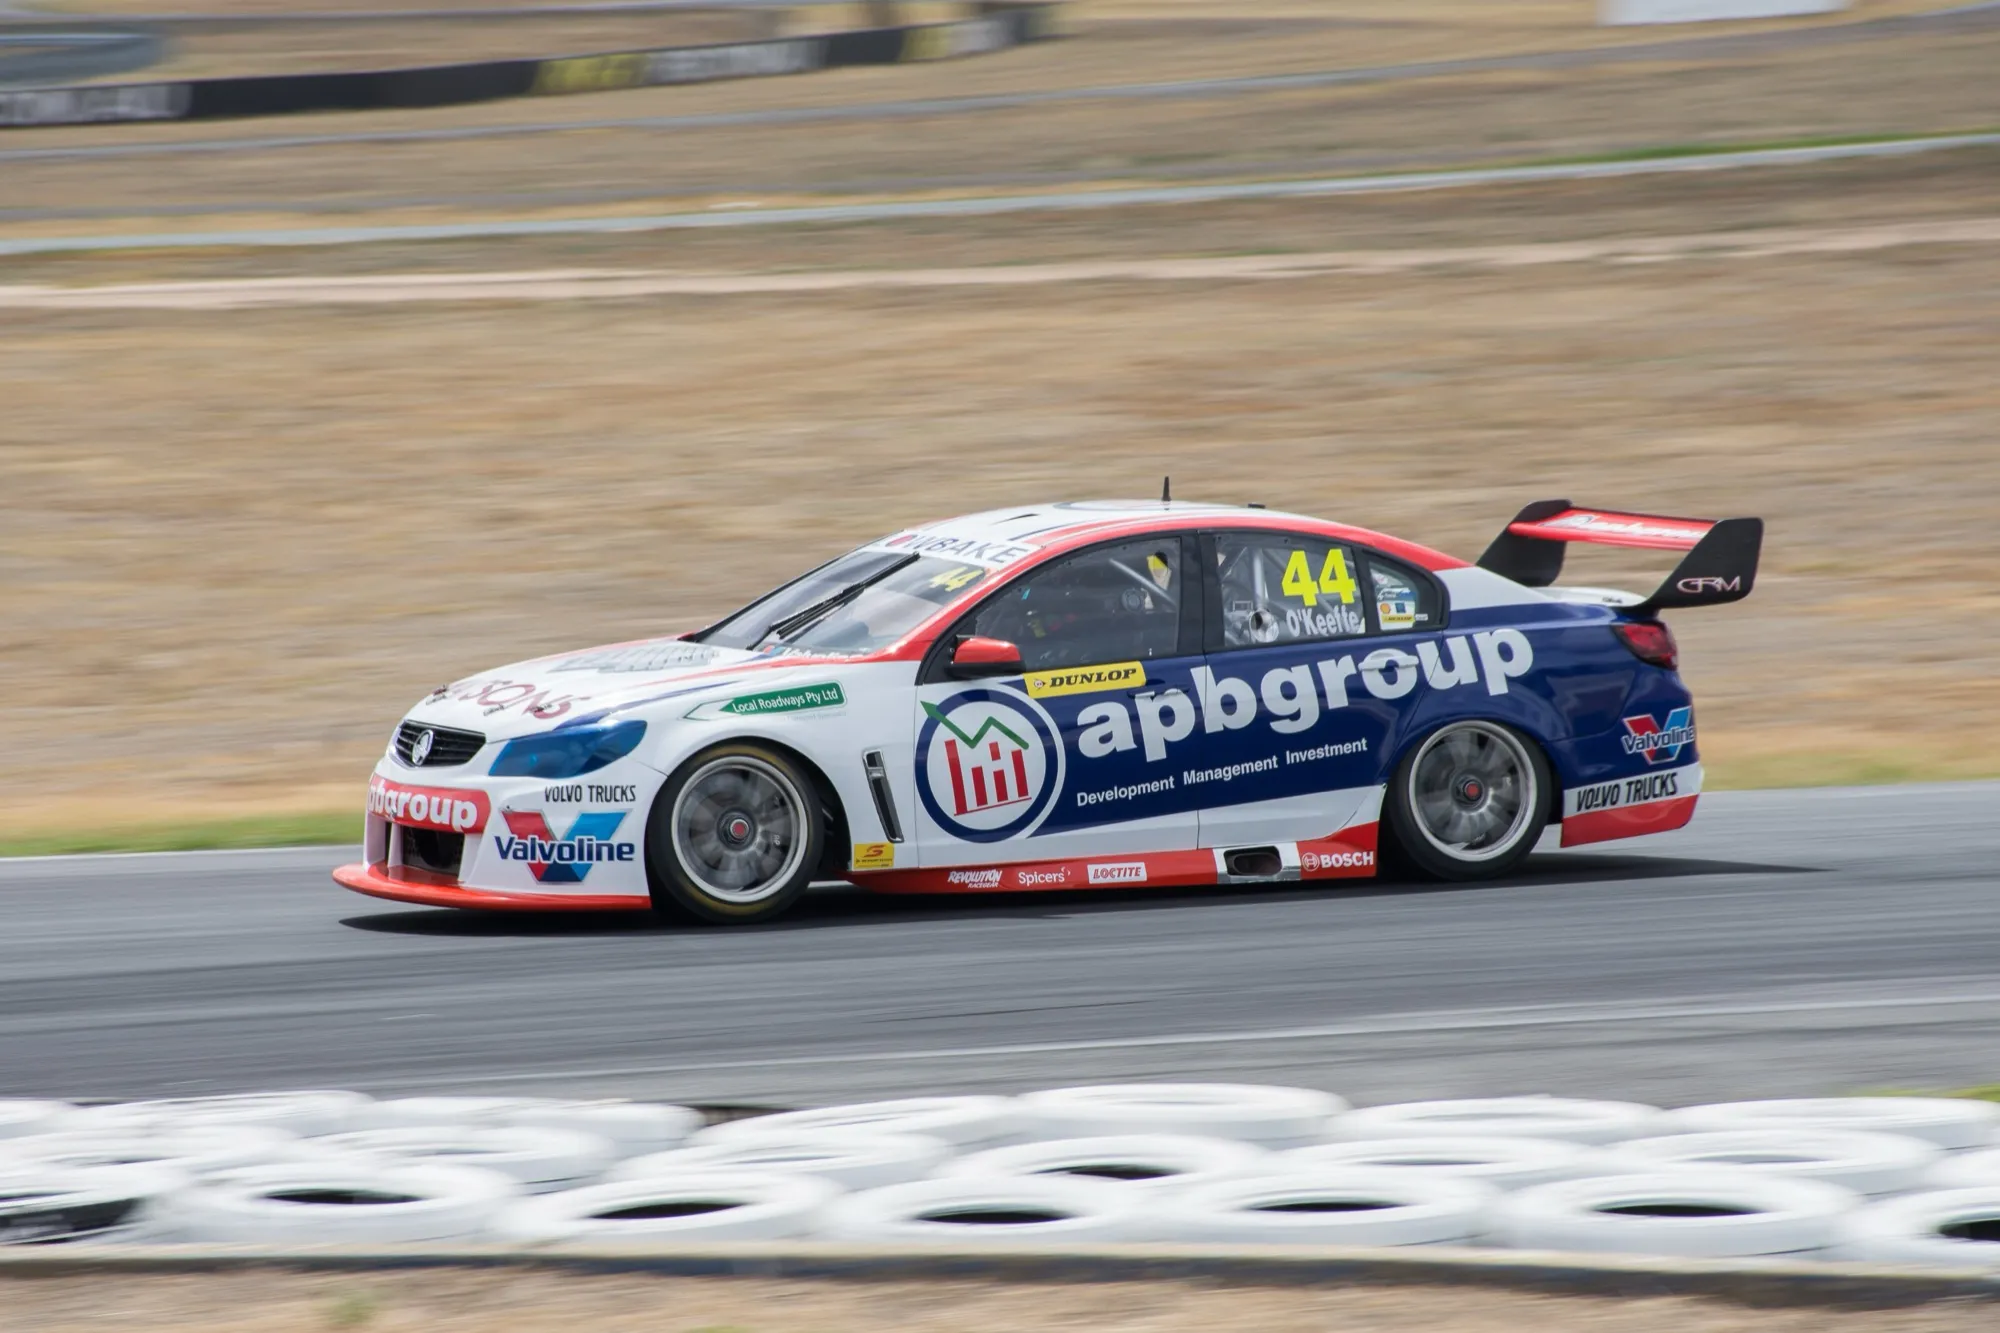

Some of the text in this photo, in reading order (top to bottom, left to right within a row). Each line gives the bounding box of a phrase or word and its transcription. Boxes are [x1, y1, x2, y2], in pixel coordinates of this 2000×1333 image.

[1281, 548, 1357, 607] 44
[1676, 575, 1742, 594] GRM
[1285, 604, 1360, 638] O'Keeffe
[1049, 667, 1137, 689] DUNLOP
[732, 687, 839, 714] Local Roadways Pty Ltd
[1076, 628, 1534, 762] apbgroup
[1621, 726, 1695, 754] Valvoline
[1077, 737, 1368, 807] Development Management Investment
[544, 784, 637, 802] VOLVO TRUCKS
[1576, 772, 1678, 812] VOLVO TRUCKS
[494, 836, 636, 861] Valvoline
[1320, 851, 1374, 868] BOSCH
[947, 868, 1003, 884] REVOLUTION
[1018, 870, 1066, 887] Spicers
[1092, 866, 1142, 880] LOCTITE
